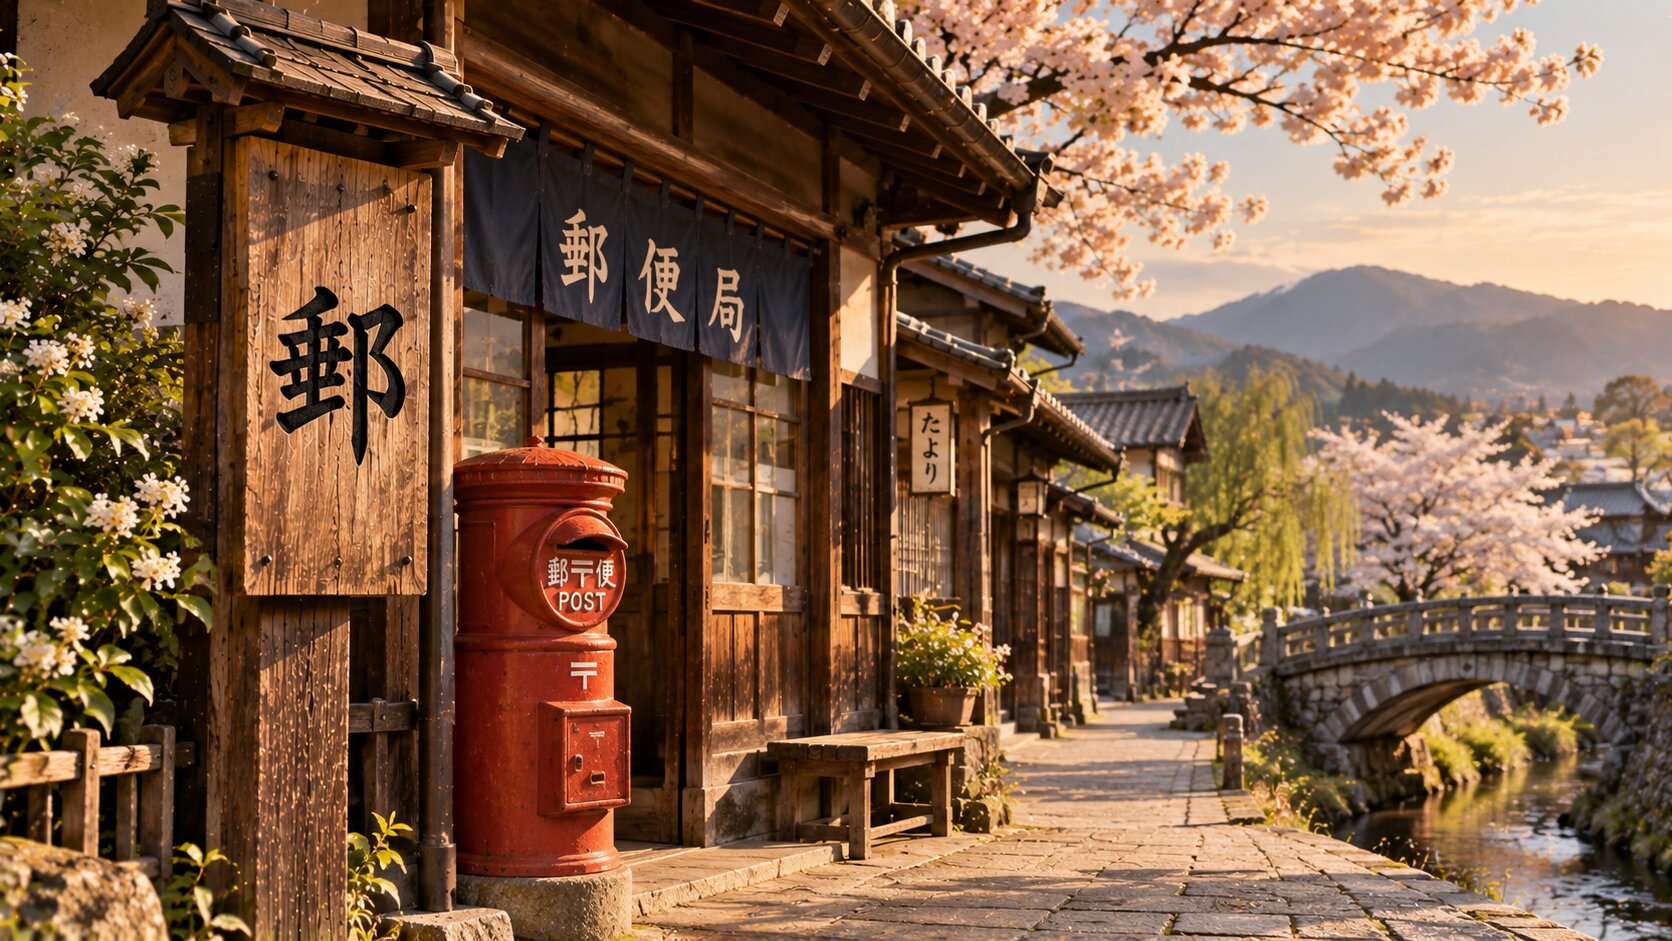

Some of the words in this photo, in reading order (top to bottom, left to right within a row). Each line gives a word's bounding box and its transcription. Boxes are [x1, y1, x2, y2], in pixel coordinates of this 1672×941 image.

[559, 208, 744, 343] 郵便局
[269, 285, 406, 464] 郵
[921, 411, 941, 485] たより
[559, 591, 606, 611] POST
